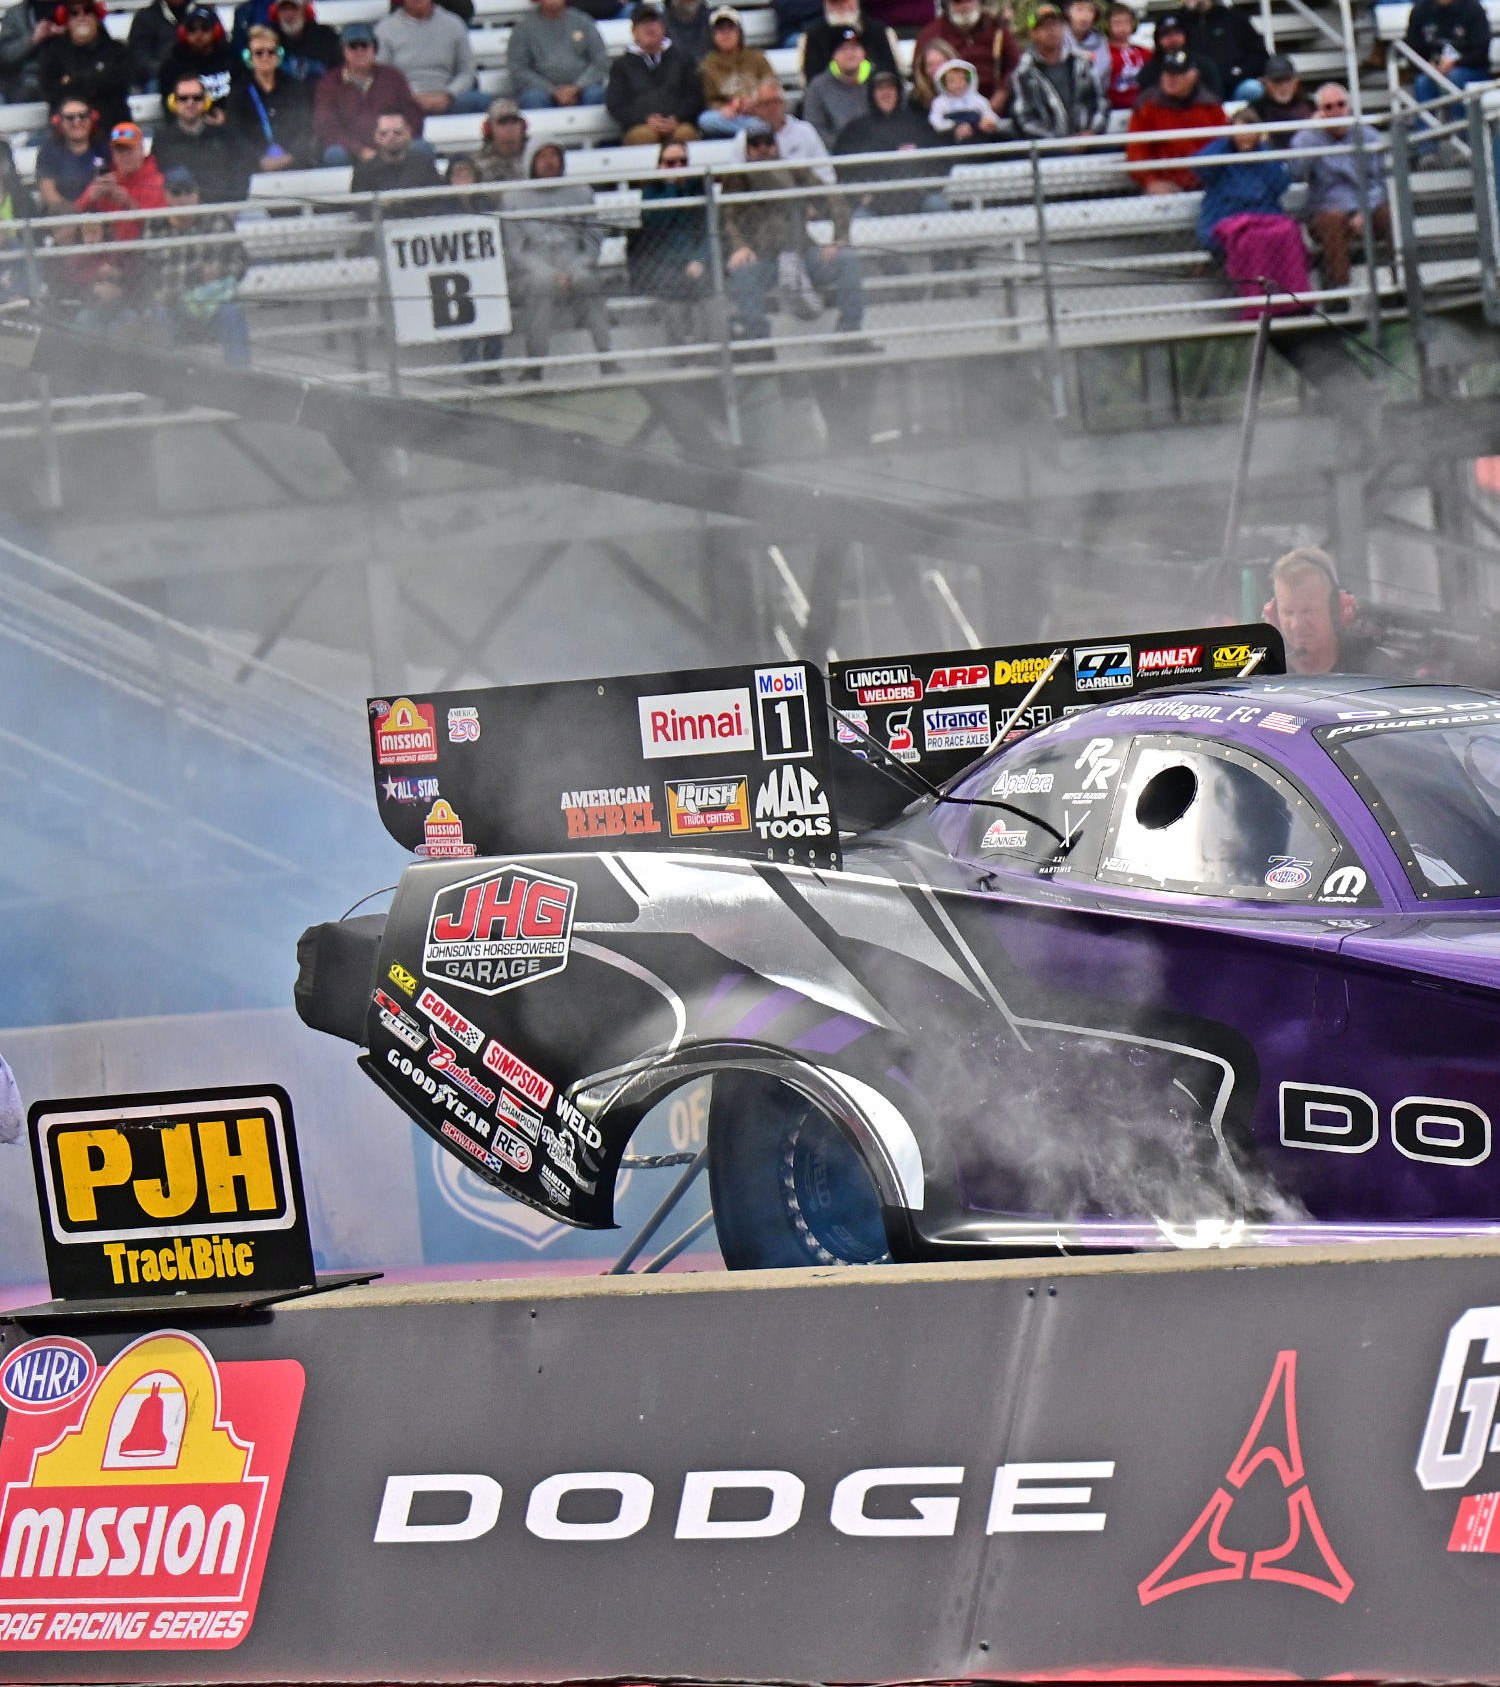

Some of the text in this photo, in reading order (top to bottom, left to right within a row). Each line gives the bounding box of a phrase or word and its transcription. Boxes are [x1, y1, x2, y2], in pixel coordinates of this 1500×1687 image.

[392, 229, 496, 270] TOWER
[428, 272, 476, 329] B
[1139, 647, 1198, 667] MANLEY
[759, 673, 803, 693] Mobil
[849, 669, 908, 688] LINCOLN
[929, 667, 988, 688] ARP
[1078, 675, 1132, 689] CARRILLO
[863, 686, 915, 702] WELDERS
[651, 703, 743, 743] Rinnai
[774, 701, 793, 749] 1
[996, 705, 1053, 730] JSEL
[1106, 701, 1262, 724] @MattHagan_FC
[1326, 716, 1490, 739] POWERED
[381, 732, 432, 751] MISSION
[927, 737, 943, 749] PRO
[944, 735, 965, 747] RACE
[966, 733, 990, 746] AXLES
[397, 778, 440, 799] ALL STAR
[560, 786, 650, 810] AMERICAN
[676, 782, 740, 814] RUSH
[755, 764, 831, 819] MAC
[565, 802, 661, 839] REBEL
[683, 811, 736, 826] TRUCK CENTERS
[755, 817, 832, 840] TOOLS
[430, 847, 473, 855] CHALLENGE
[981, 836, 1027, 848] SUNNEN
[433, 876, 571, 943] JHG
[483, 941, 565, 956] HORSEPOWERED
[445, 959, 541, 984] GARAGE
[422, 993, 468, 1032] COMP
[487, 1046, 549, 1102] SIMPSON
[387, 1048, 491, 1138] GOODYEAR
[500, 1101, 537, 1134] CHAMPION
[556, 1094, 602, 1149] WELD
[443, 1123, 488, 1161] SCHWARTZ
[57, 1117, 277, 1222] PJH
[103, 1235, 254, 1285] TrackBite
[10, 1351, 80, 1398] NHRA
[373, 1460, 1117, 1543] DODGE
[1, 1503, 246, 1577] MISSION
[45, 1610, 150, 1640] RACING
[149, 1610, 249, 1640] SERIES
